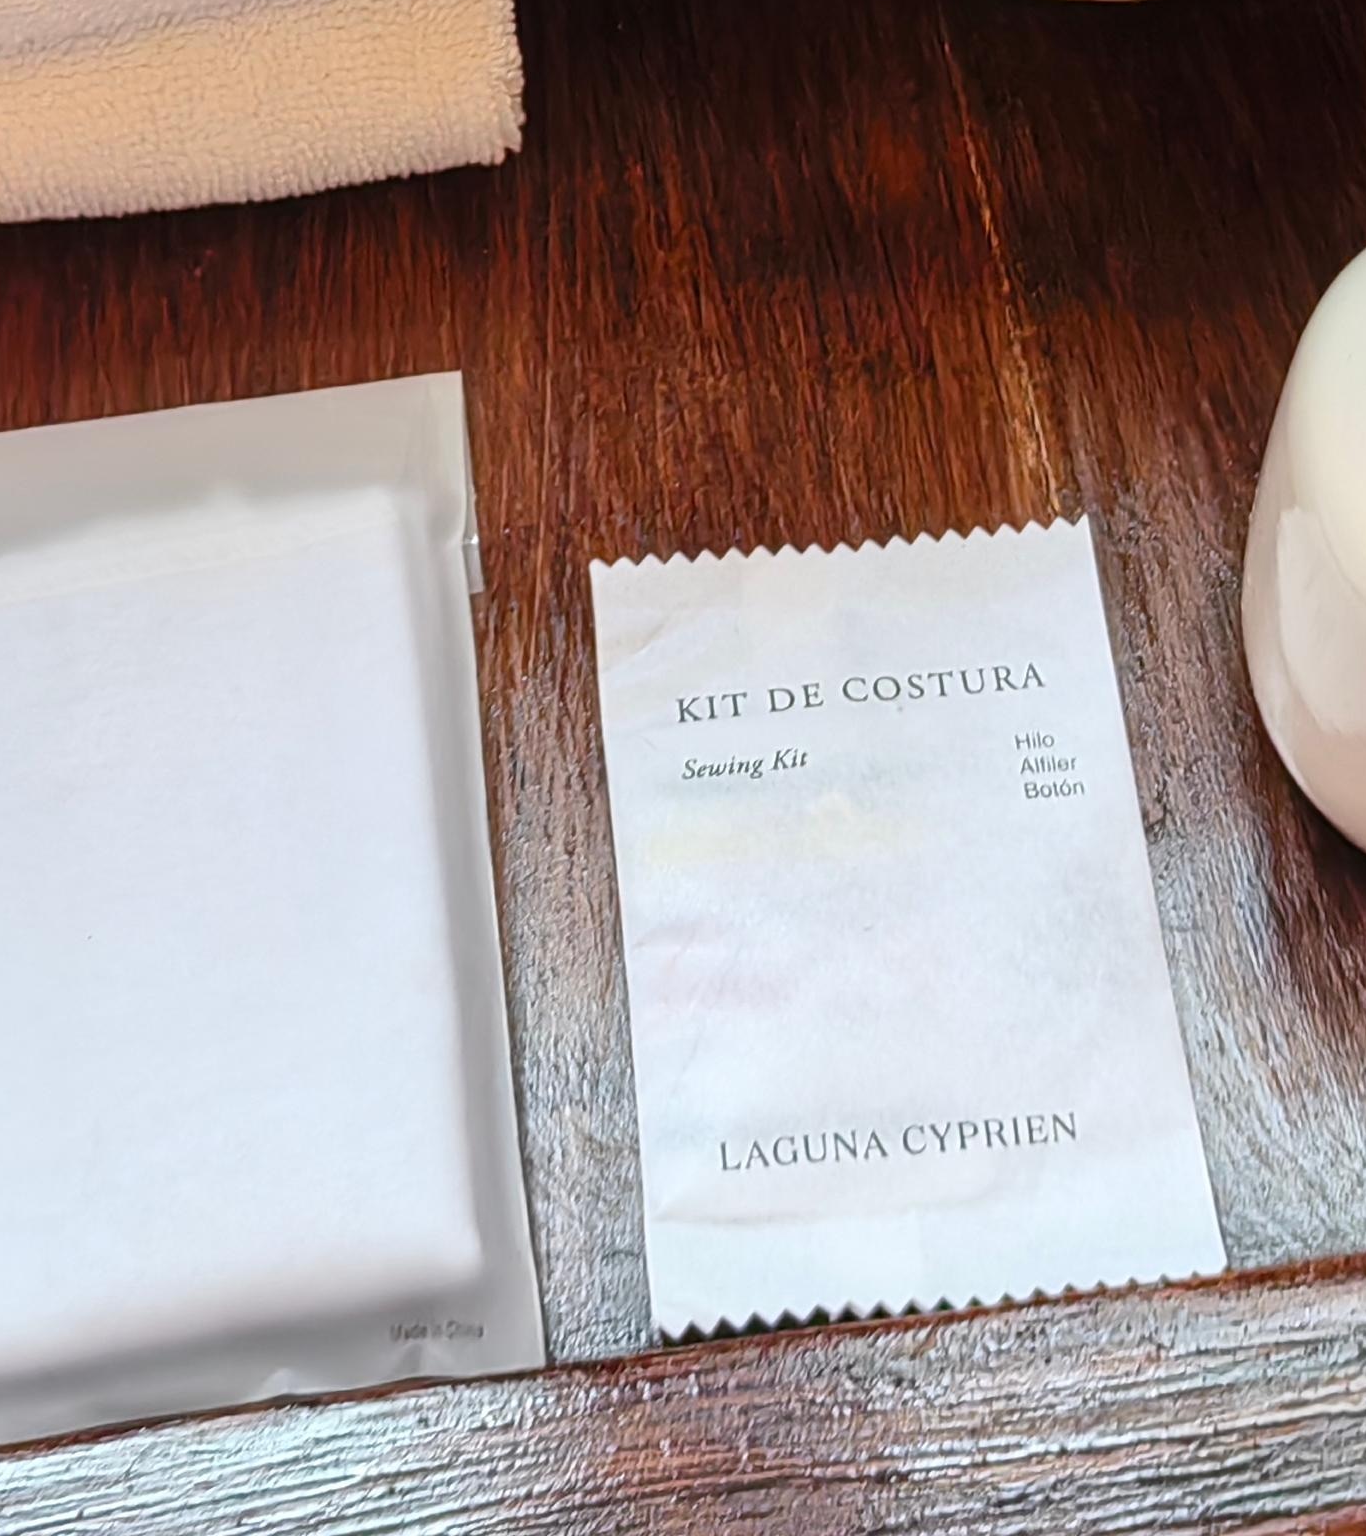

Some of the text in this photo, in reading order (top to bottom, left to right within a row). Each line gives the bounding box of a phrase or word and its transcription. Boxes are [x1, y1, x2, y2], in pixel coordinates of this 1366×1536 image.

[675, 662, 1046, 723] KIT DE COSTURA
[1014, 731, 1056, 751] Hilo
[681, 747, 809, 780] Sewing Kit
[1020, 756, 1077, 775] Alfiler
[1024, 779, 1085, 799] Botón
[719, 1112, 1078, 1172] LAGUNA CYPRIEN
